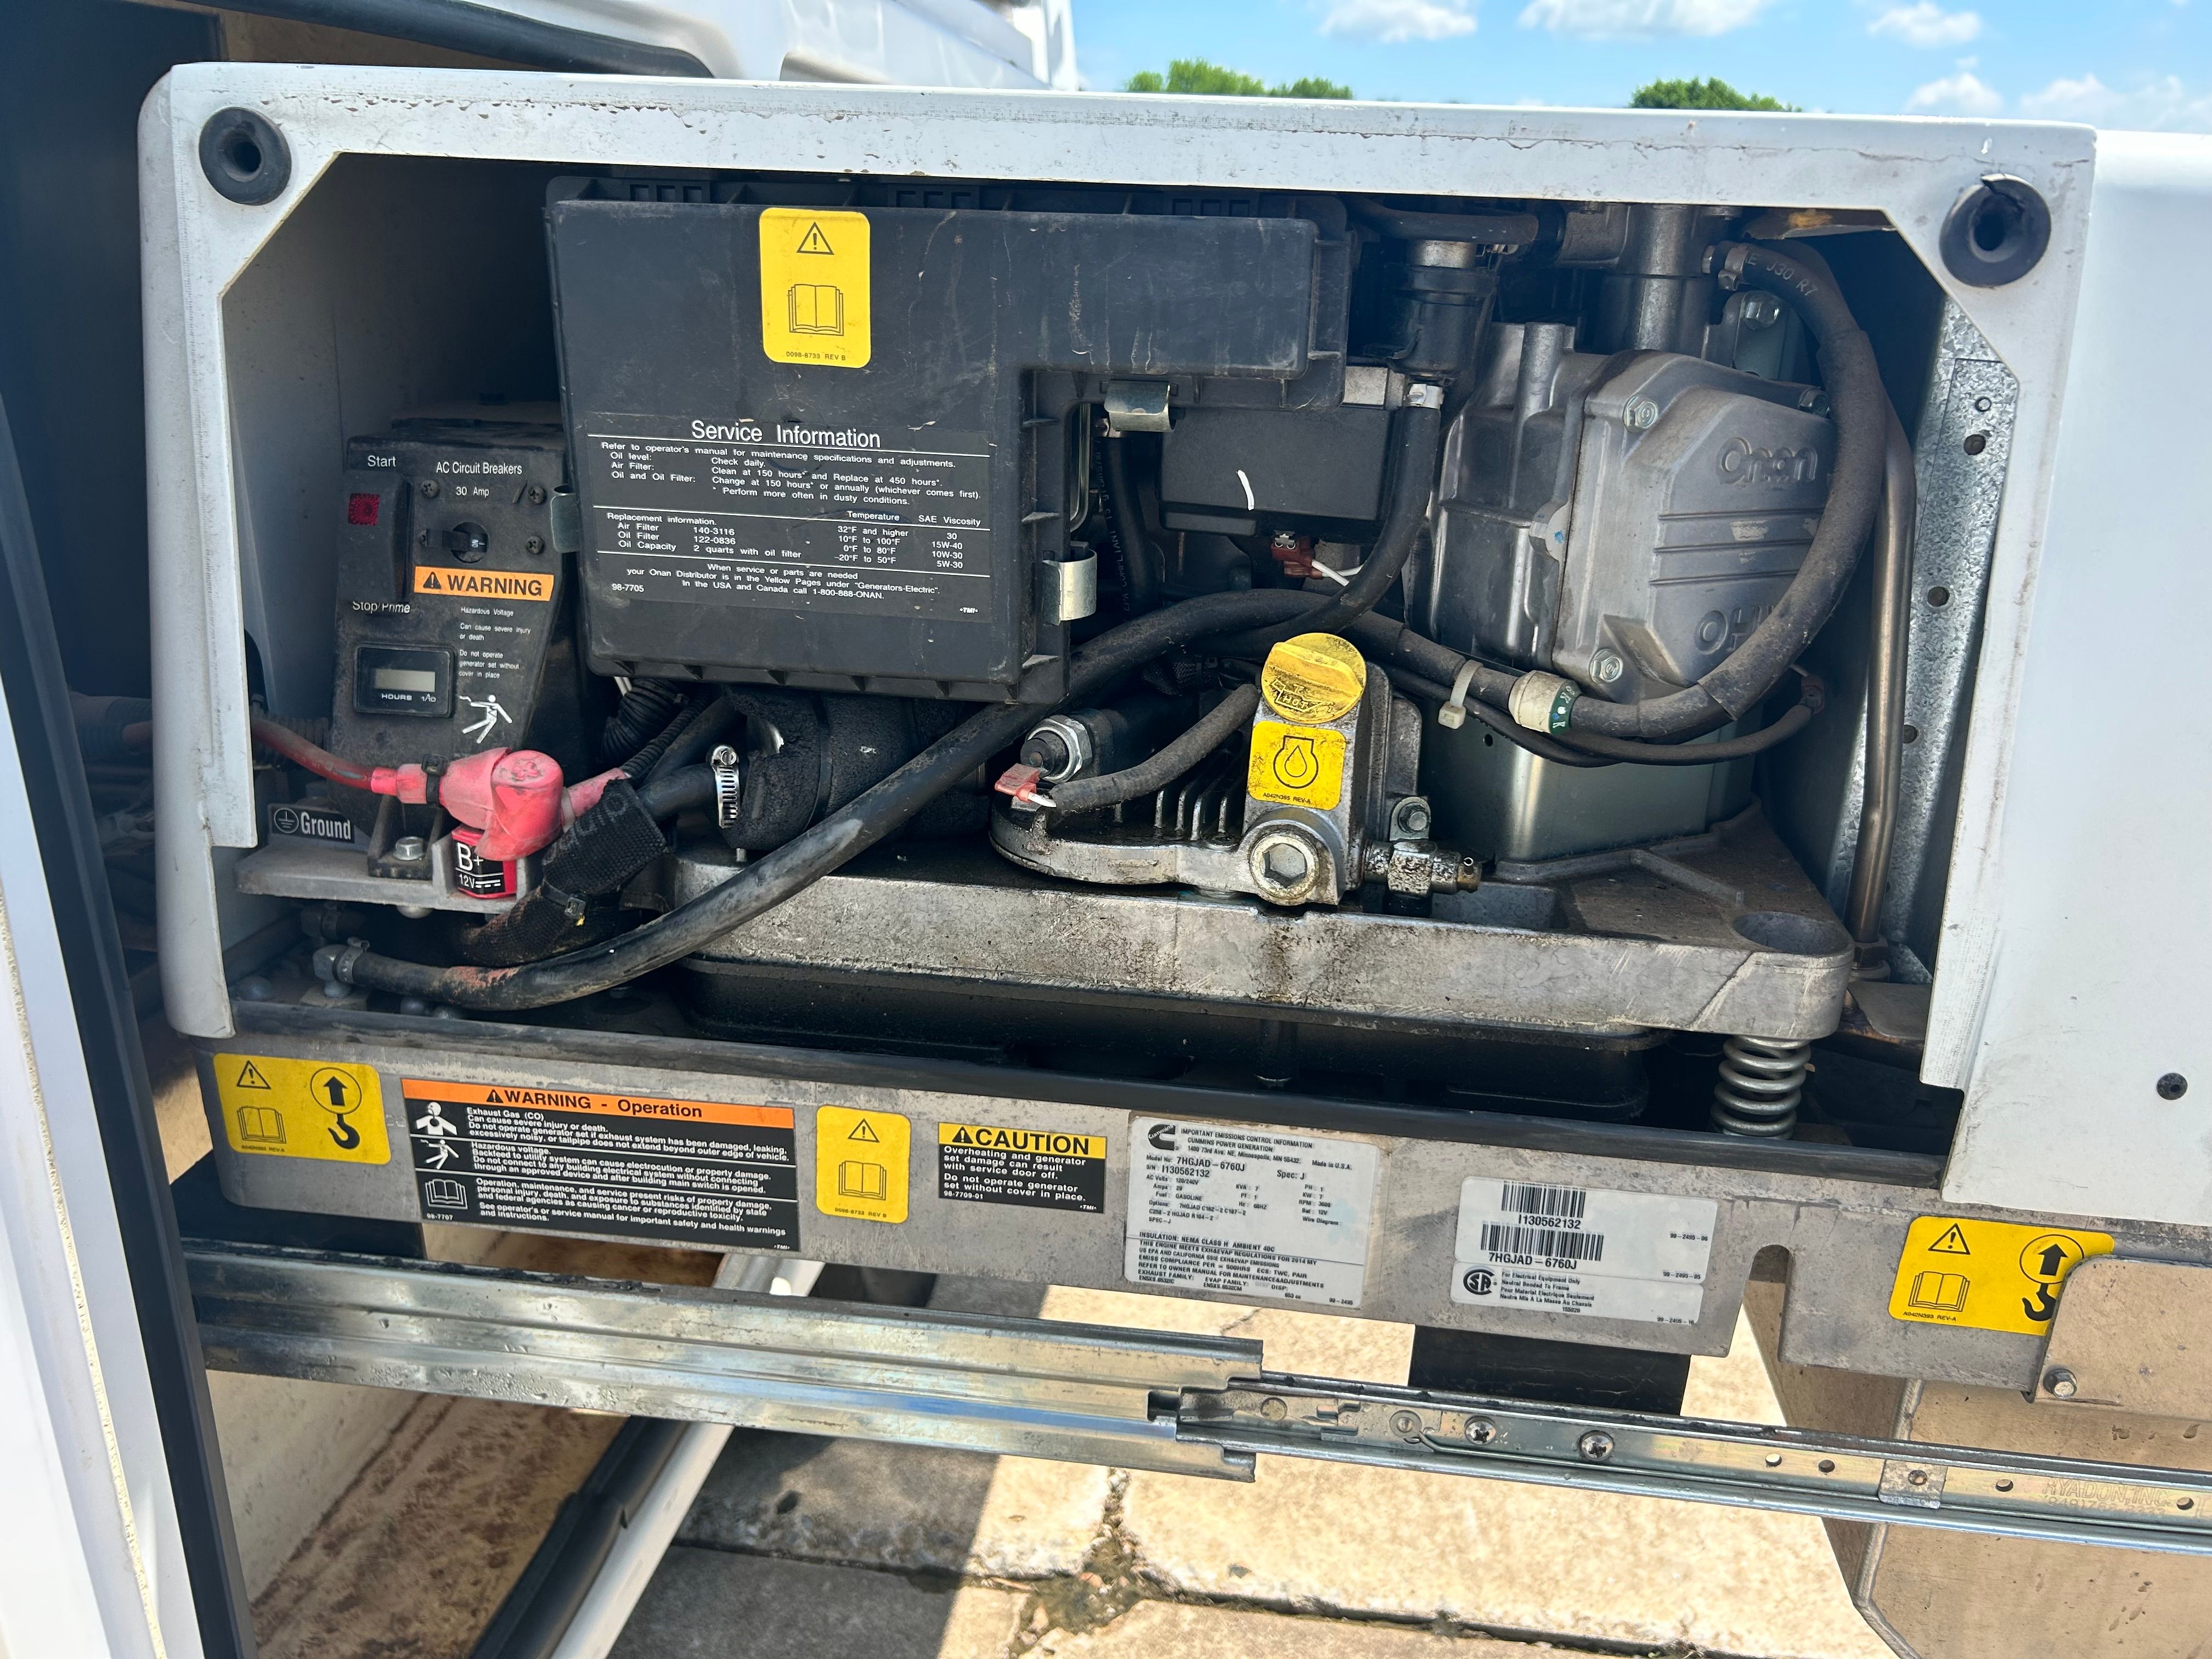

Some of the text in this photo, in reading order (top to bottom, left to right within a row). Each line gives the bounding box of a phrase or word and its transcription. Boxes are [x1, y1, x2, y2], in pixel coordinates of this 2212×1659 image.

[1767, 261, 1819, 296] J30 R7
[691, 420, 881, 448] Service Information
[368, 455, 396, 468] Start
[602, 442, 625, 450] Refer
[631, 443, 640, 451] to
[646, 445, 689, 454] operator's
[751, 450, 808, 460] maintenance
[814, 454, 872, 464] specifications
[900, 458, 956, 468] adjustments.
[611, 452, 623, 460] Oil
[629, 453, 652, 461] level:
[711, 458, 738, 466] Check
[436, 461, 522, 475] AC Circuit Breakers
[630, 462, 654, 471] Filter:
[712, 467, 736, 475] Clean
[833, 473, 868, 483] Replace
[456, 487, 489, 498] 30 Amp
[607, 512, 717, 526] Replacement information.
[847, 511, 981, 527] Temperature SAE Viscosity
[693, 527, 735, 535] 140-3116
[883, 529, 909, 537] higher
[637, 541, 676, 552] Capacity
[706, 546, 734, 555] quarts
[741, 548, 758, 556] with
[781, 550, 802, 558] filter
[693, 536, 736, 545] 122-0836
[932, 541, 962, 550] 15W-40
[932, 551, 962, 560] 10W-30
[448, 574, 542, 596] WARNING
[611, 583, 644, 592] 98-7705
[757, 585, 788, 593] Canada
[461, 606, 514, 617] Hazardous Voltage
[460, 623, 471, 631] Can
[516, 626, 531, 635] injury
[459, 661, 484, 669] generator
[381, 693, 412, 701] HOURS
[1283, 696, 1308, 709] HOT
[301, 811, 351, 840] Ground
[457, 842, 484, 872] B+
[459, 873, 475, 889] 12V
[504, 1090, 702, 1118] WARNING Operation
[467, 1107, 544, 1121] Exhaust Gas (CO)
[975, 1128, 1089, 1155] CAUTION
[1181, 1128, 1213, 1137] IMPORTANT
[1246, 1136, 1272, 1144] CONTROL
[1274, 1139, 1312, 1148] INFORMATION
[1188, 1137, 1273, 1152] CUMMINS POWER GENERATION
[944, 1146, 1086, 1166] Overheating and generator
[964, 1156, 1005, 1167] damage
[1033, 1163, 1063, 1171] result
[944, 1163, 1058, 1180] with service door off.
[944, 1172, 957, 1181] Do
[984, 1177, 1023, 1187] operate
[1028, 1181, 1079, 1192] generator
[944, 1189, 983, 1199] 98-7709-01
[964, 1183, 1002, 1193] without
[1007, 1187, 1035, 1197] cover
[1055, 1191, 1086, 1201] place.
